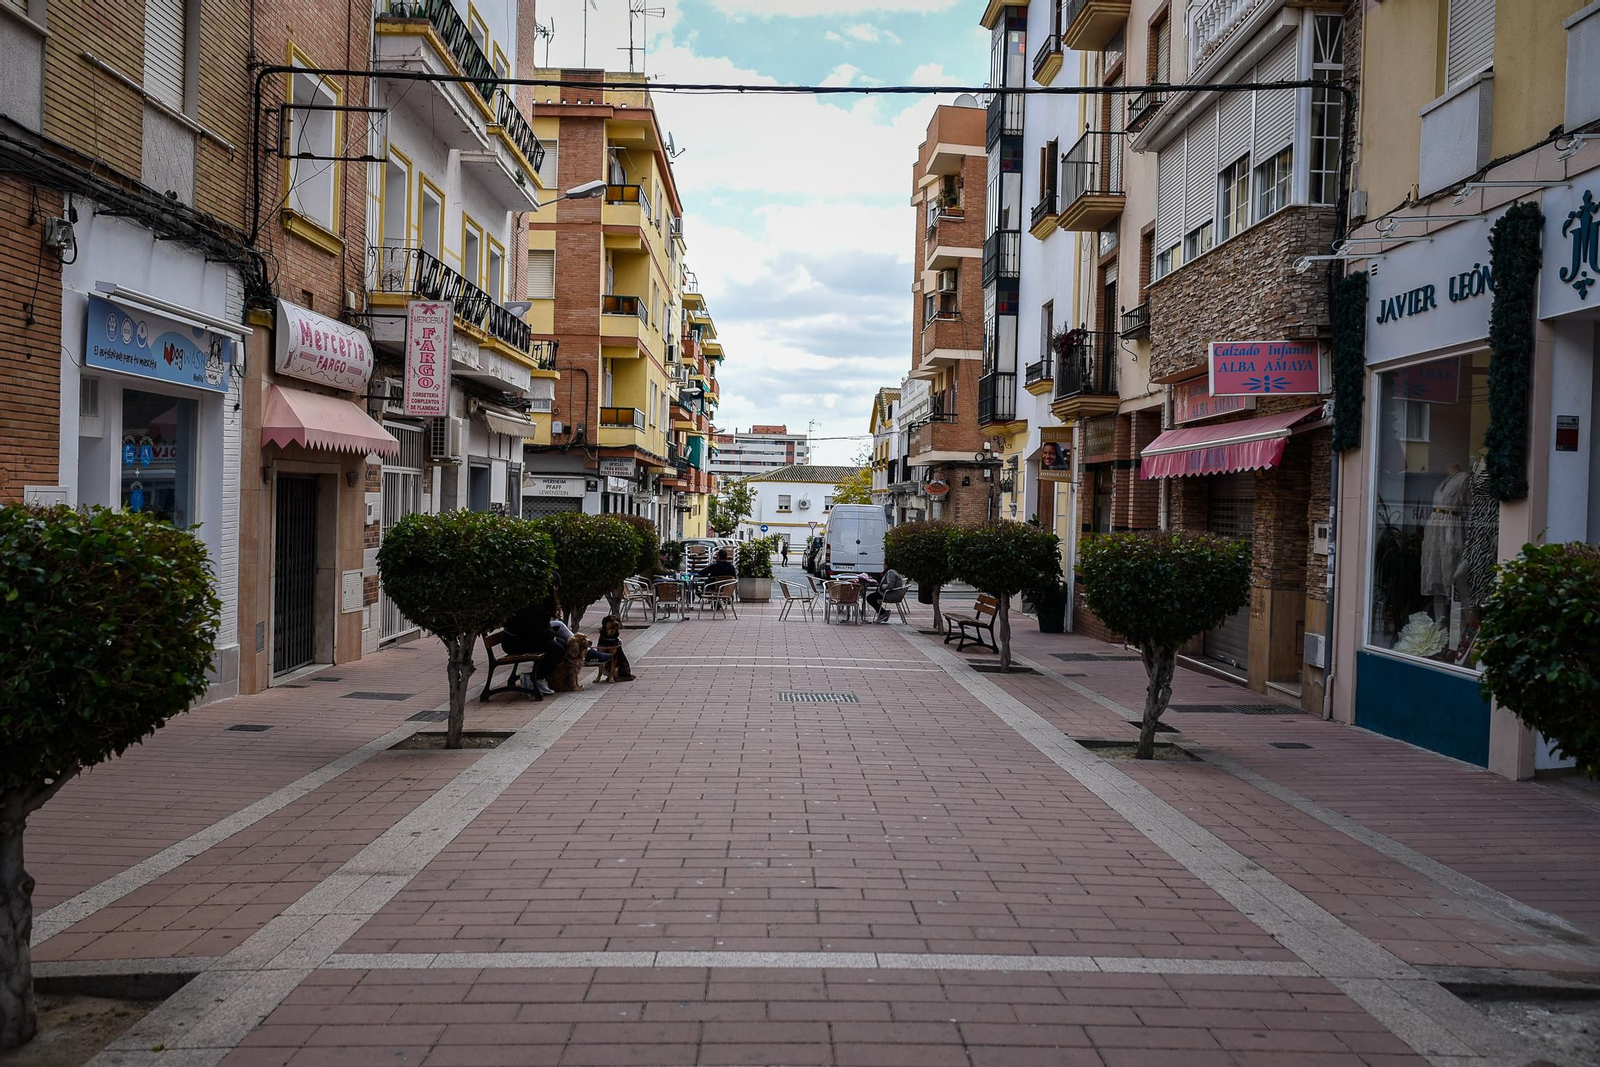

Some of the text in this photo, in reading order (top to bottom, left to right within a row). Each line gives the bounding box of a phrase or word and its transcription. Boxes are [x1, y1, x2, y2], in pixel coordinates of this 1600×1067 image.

[1376, 284, 1437, 325] JAVIER
[93, 344, 99, 357] El
[122, 354, 134, 366] para
[418, 327, 436, 389] FARGO
[1214, 341, 1314, 361] Calzado Infantil
[316, 355, 347, 373] FARGO
[1218, 360, 1314, 373] ALBA AMAYA
[412, 391, 439, 399] CORSETERIA
